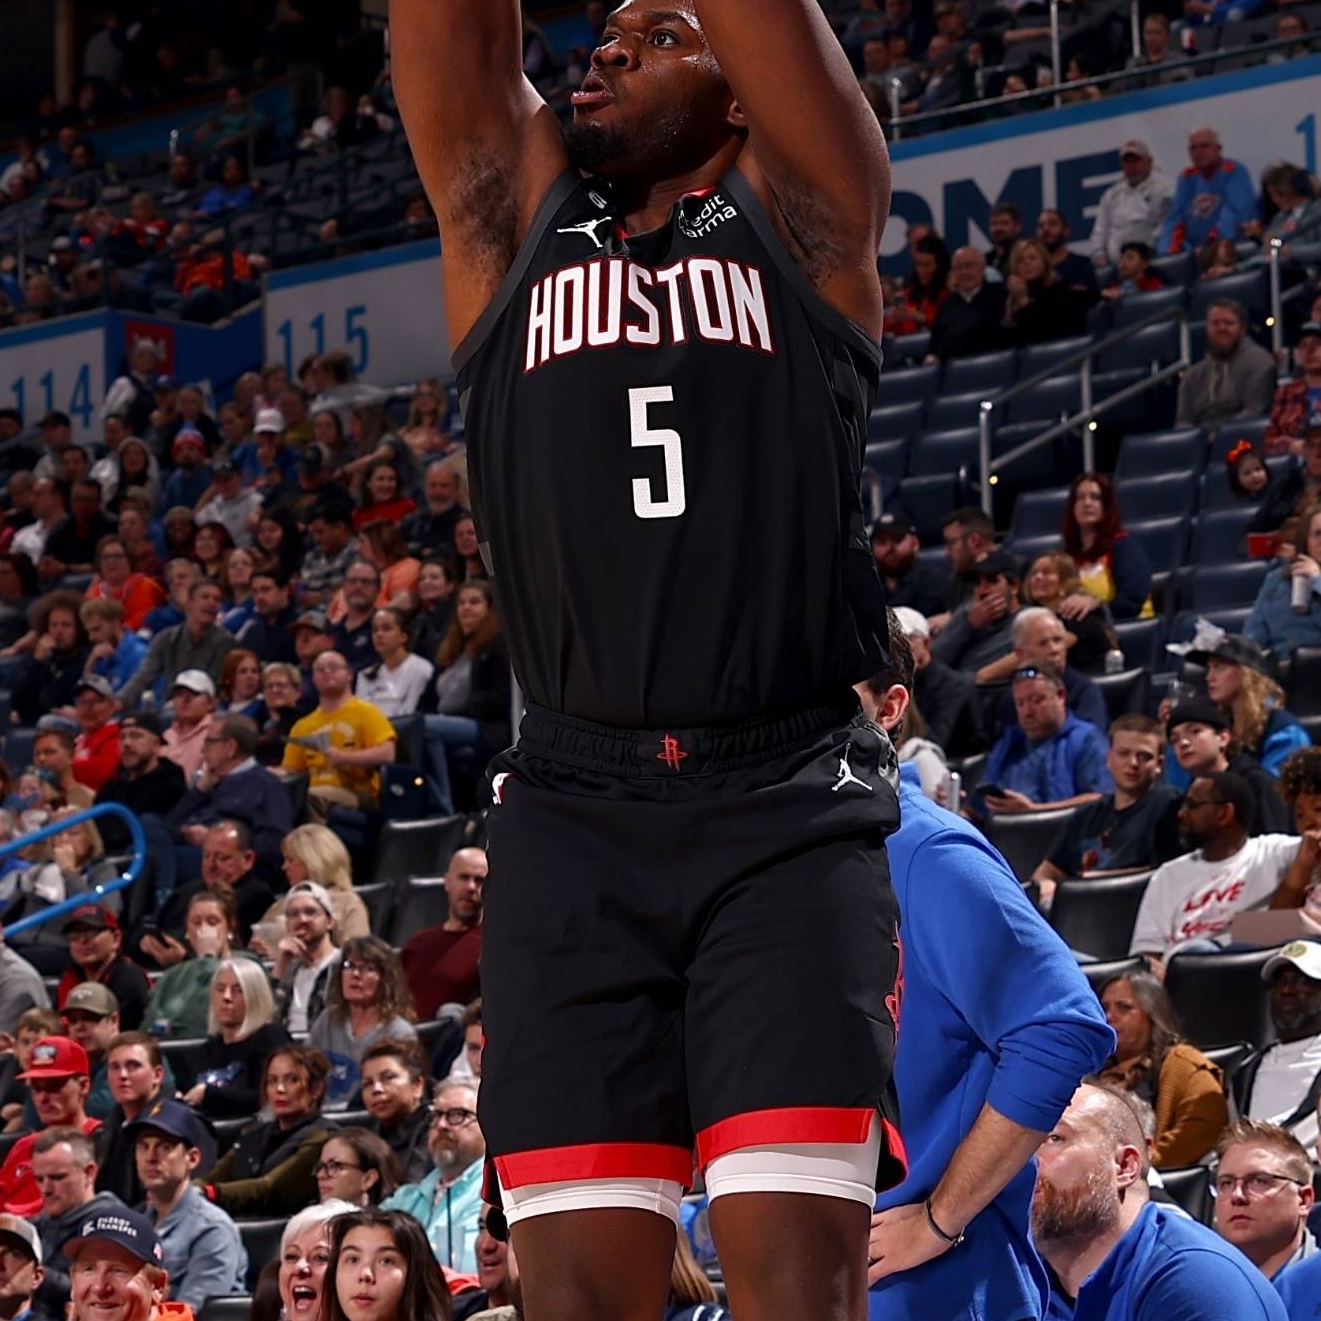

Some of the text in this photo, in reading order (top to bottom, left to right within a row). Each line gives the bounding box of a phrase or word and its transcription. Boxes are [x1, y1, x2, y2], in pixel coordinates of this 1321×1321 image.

[277, 304, 369, 381] 115
[524, 256, 775, 373] HOUSTON
[10, 363, 94, 429] 114
[628, 385, 686, 519] 5
